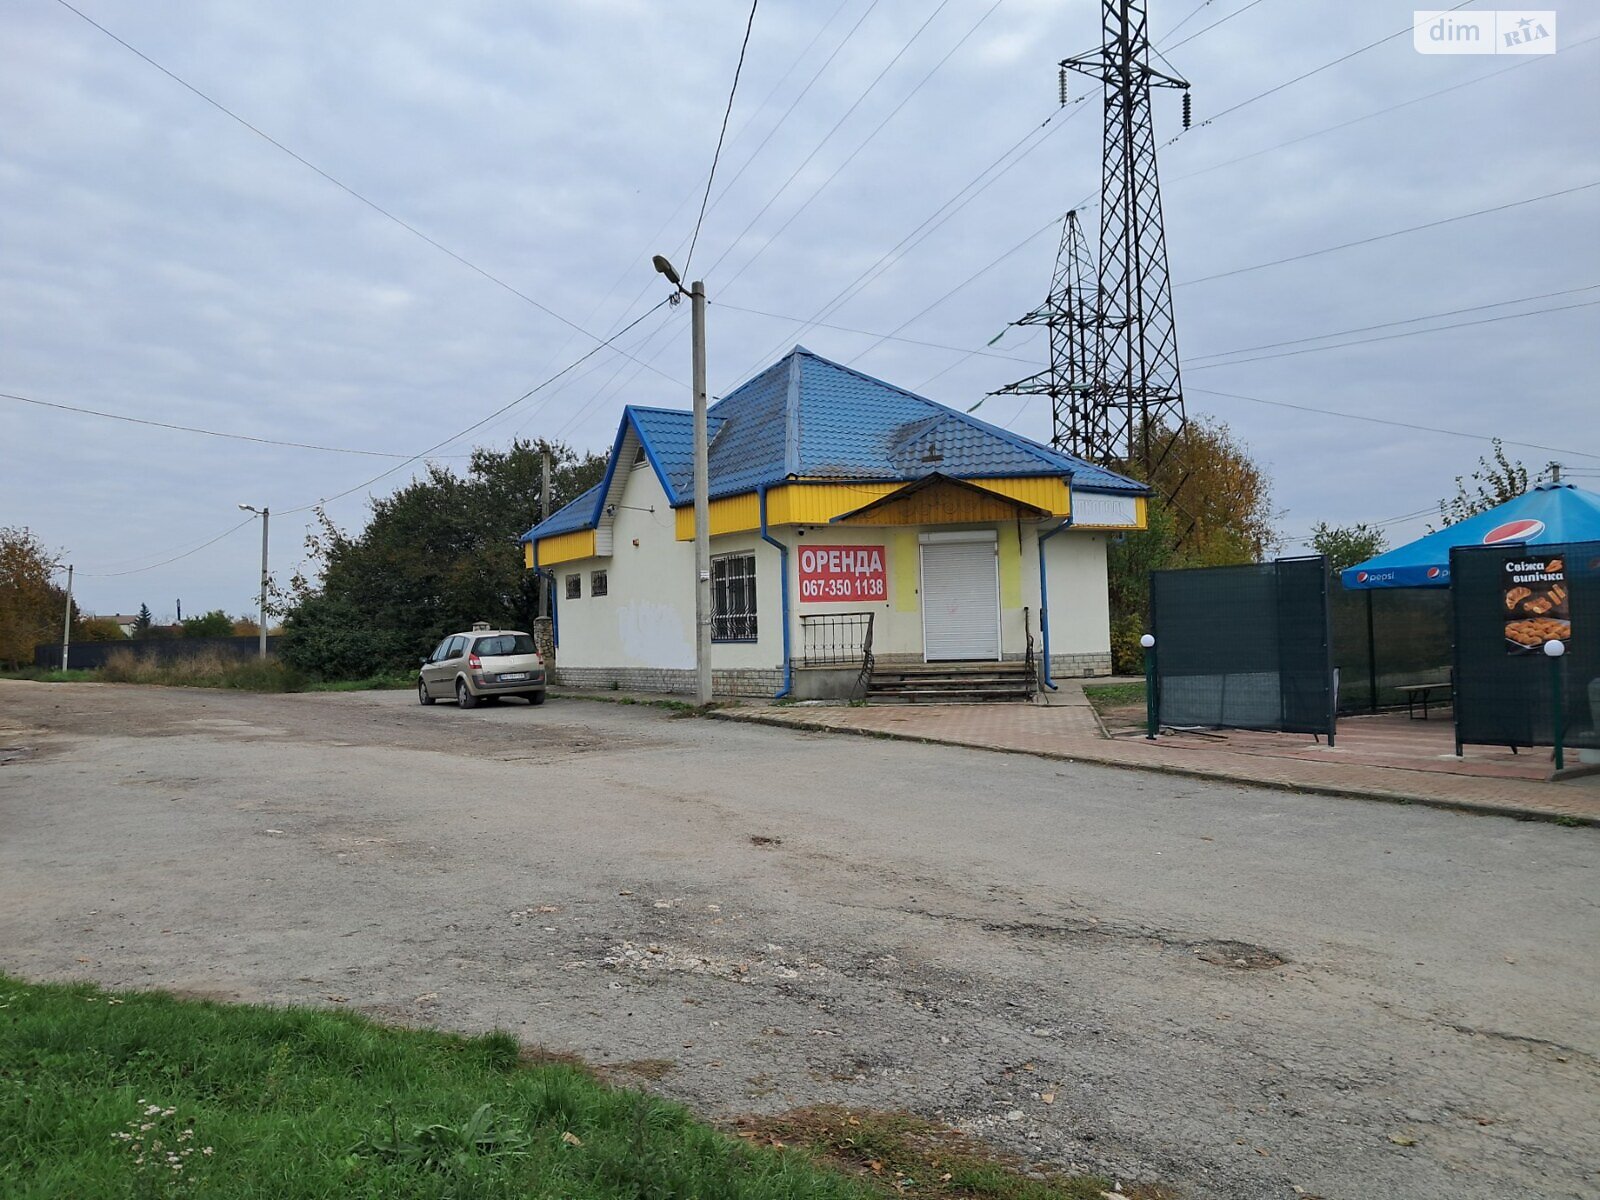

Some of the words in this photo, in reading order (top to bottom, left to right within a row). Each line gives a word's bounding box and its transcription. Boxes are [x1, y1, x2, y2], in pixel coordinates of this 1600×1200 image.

[801, 550, 883, 577] ОРЕНДА
[1505, 561, 1545, 572] Свіжа
[1369, 571, 1395, 583] pepsi
[1513, 571, 1564, 583] випічка
[802, 579, 851, 596] 067-350
[855, 578, 884, 596] 1138
